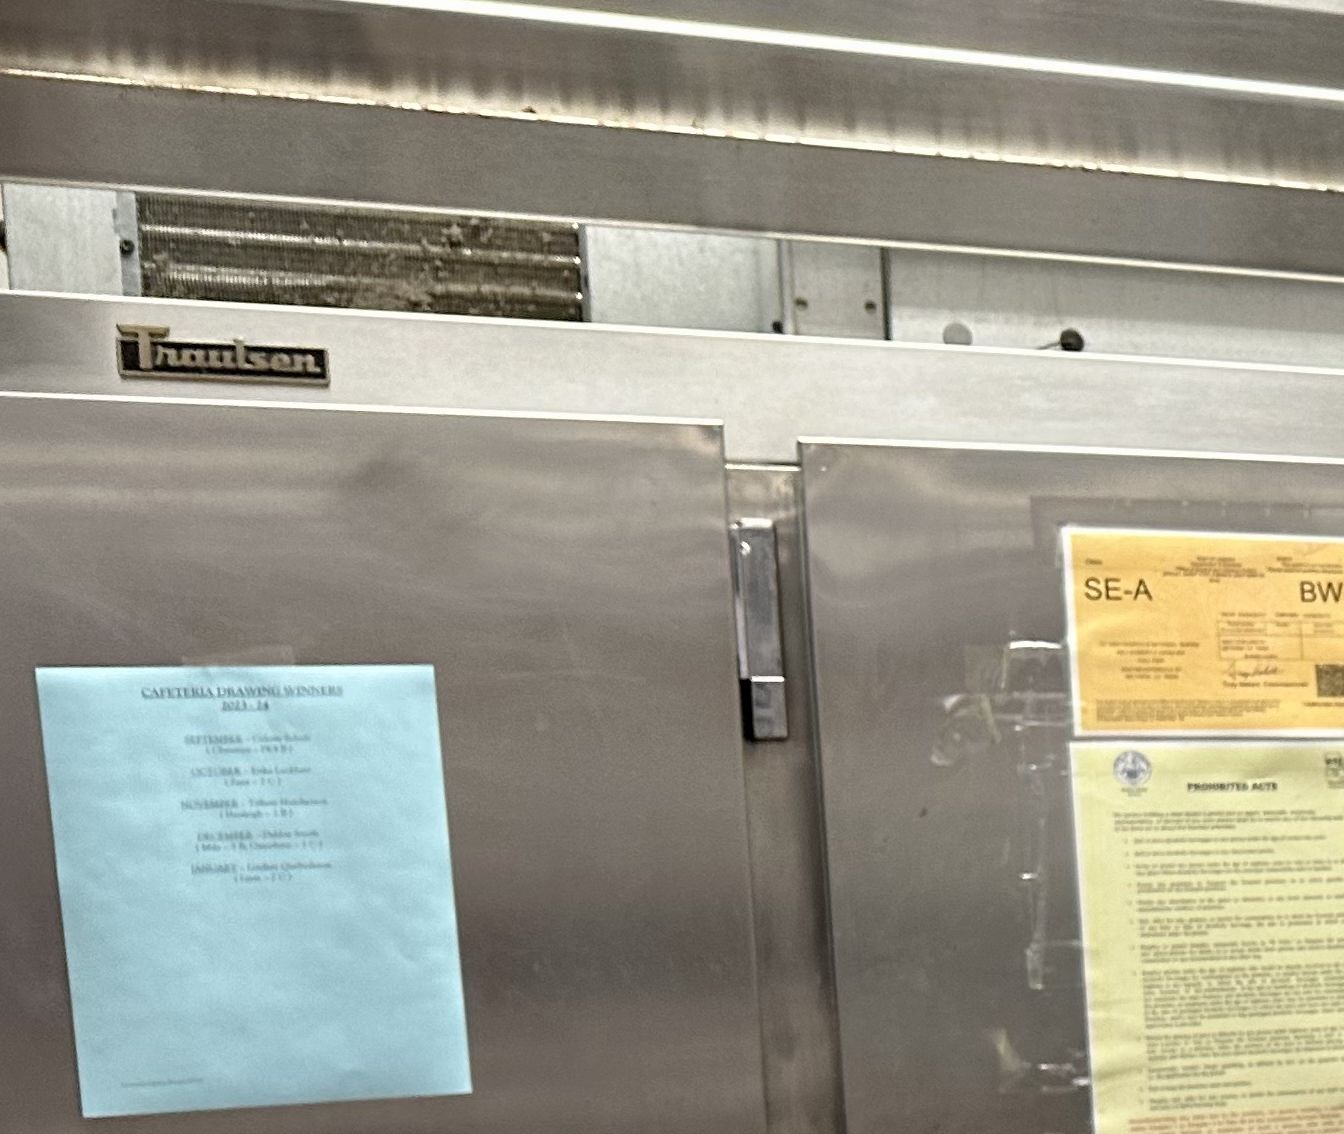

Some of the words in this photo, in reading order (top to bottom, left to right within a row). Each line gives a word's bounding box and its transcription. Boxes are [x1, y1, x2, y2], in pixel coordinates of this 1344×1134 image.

[1084, 577, 1153, 601] SE-A
[1299, 581, 1344, 602] BW
[141, 686, 214, 699] CAFETERIA
[216, 686, 281, 698] DRAWING
[284, 685, 344, 697] WINNERS
